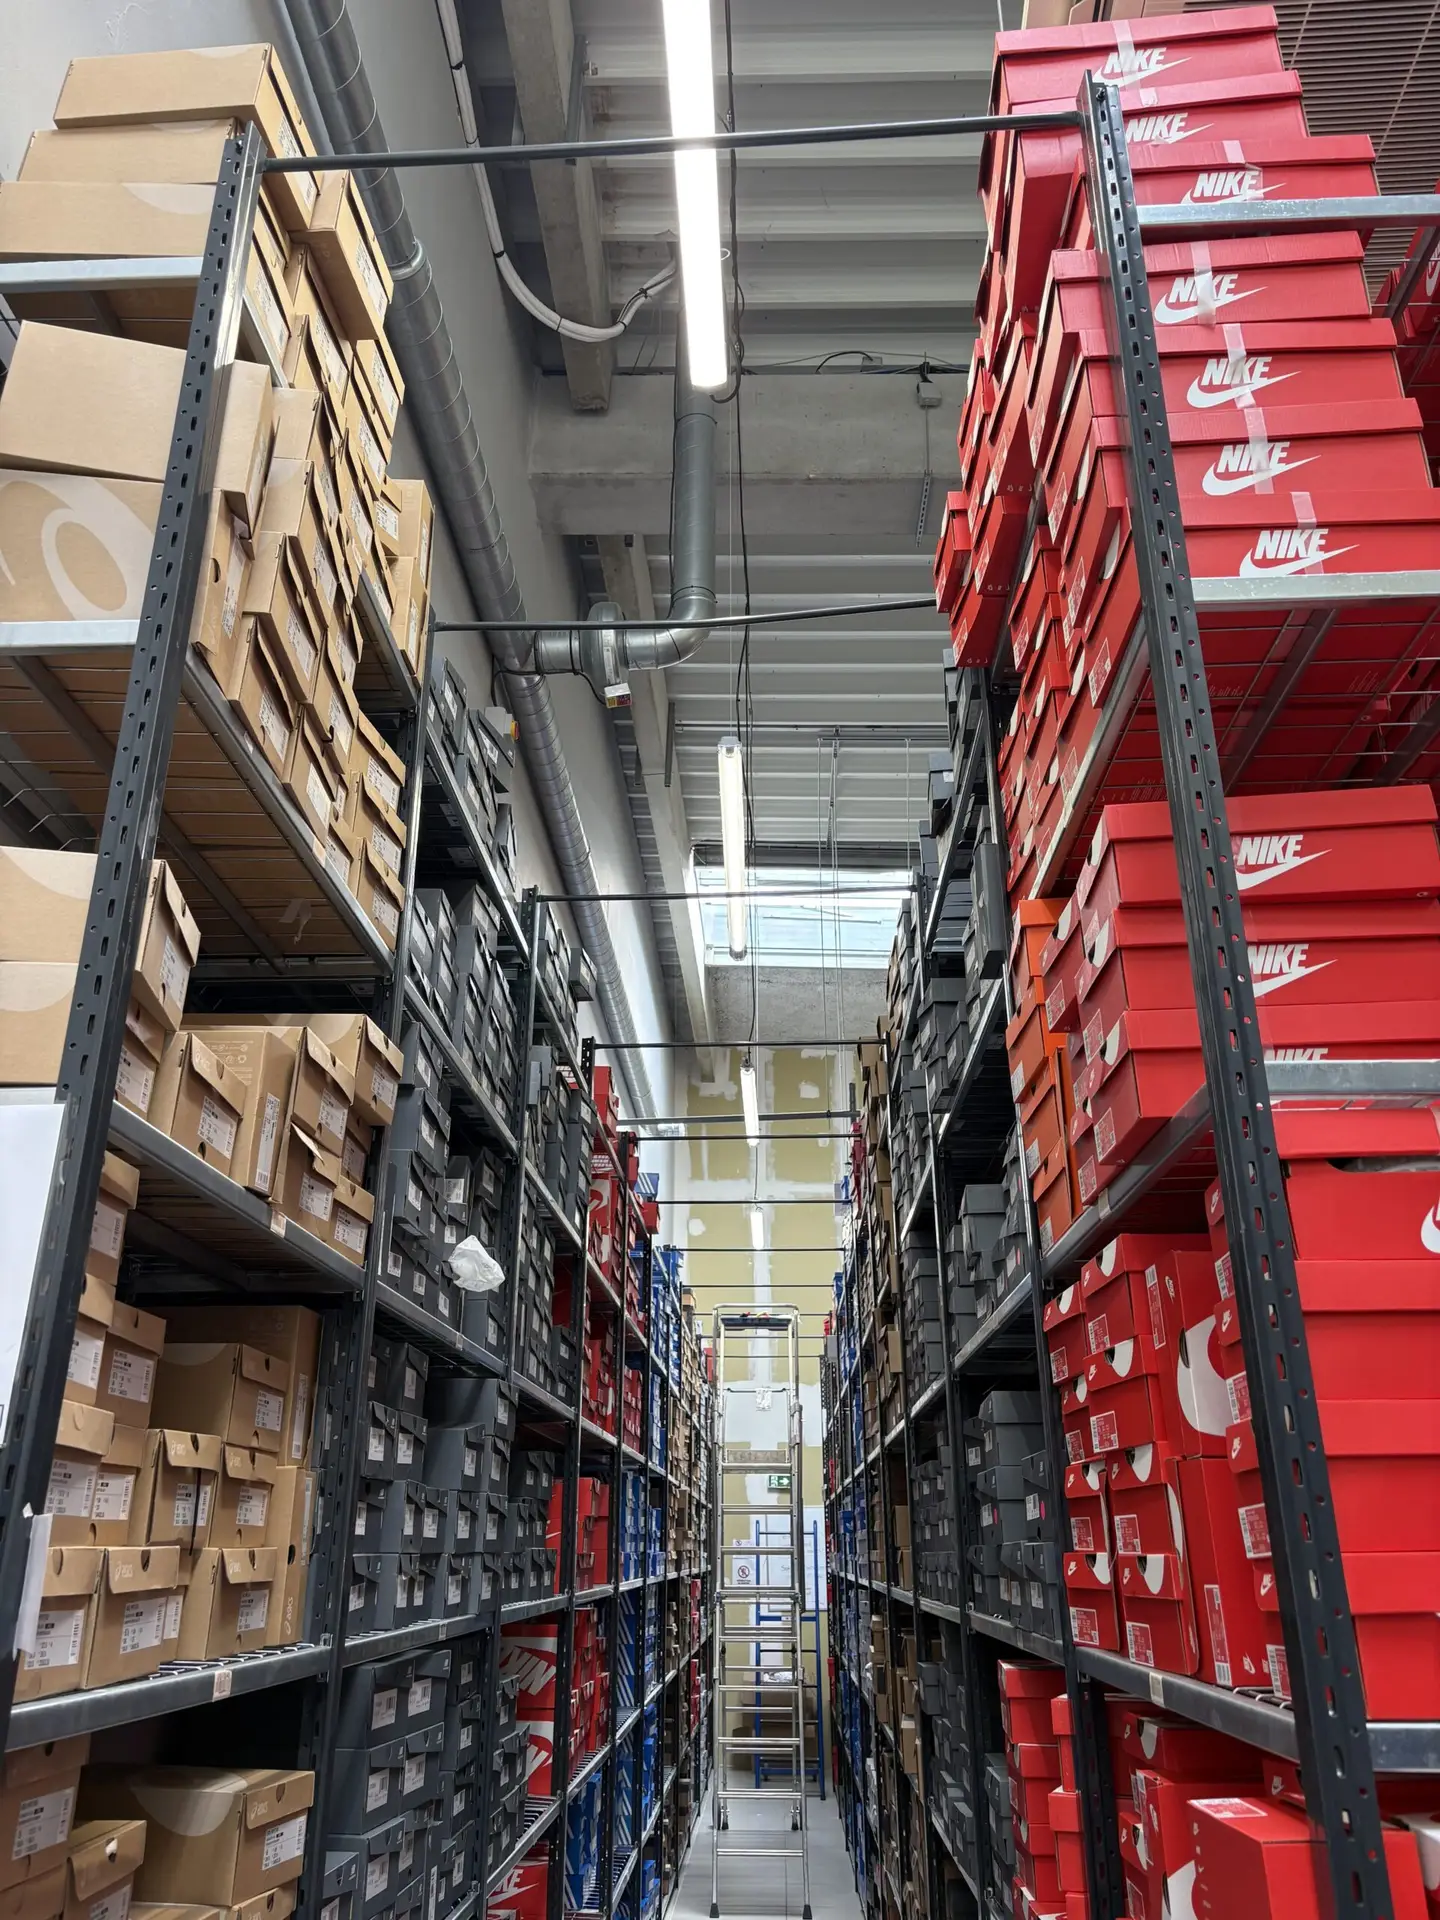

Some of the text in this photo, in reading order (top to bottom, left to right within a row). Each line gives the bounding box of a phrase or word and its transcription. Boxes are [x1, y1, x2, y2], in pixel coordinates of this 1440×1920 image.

[1104, 47, 1166, 74] NKE
[1126, 112, 1188, 142] NIKE
[1193, 170, 1260, 197] NIKE
[1201, 356, 1272, 386] NIKE
[1216, 441, 1290, 473] NIKE
[1254, 528, 1329, 560] NIKE
[1237, 834, 1304, 866] NIKE
[1247, 943, 1310, 975] NIKE
